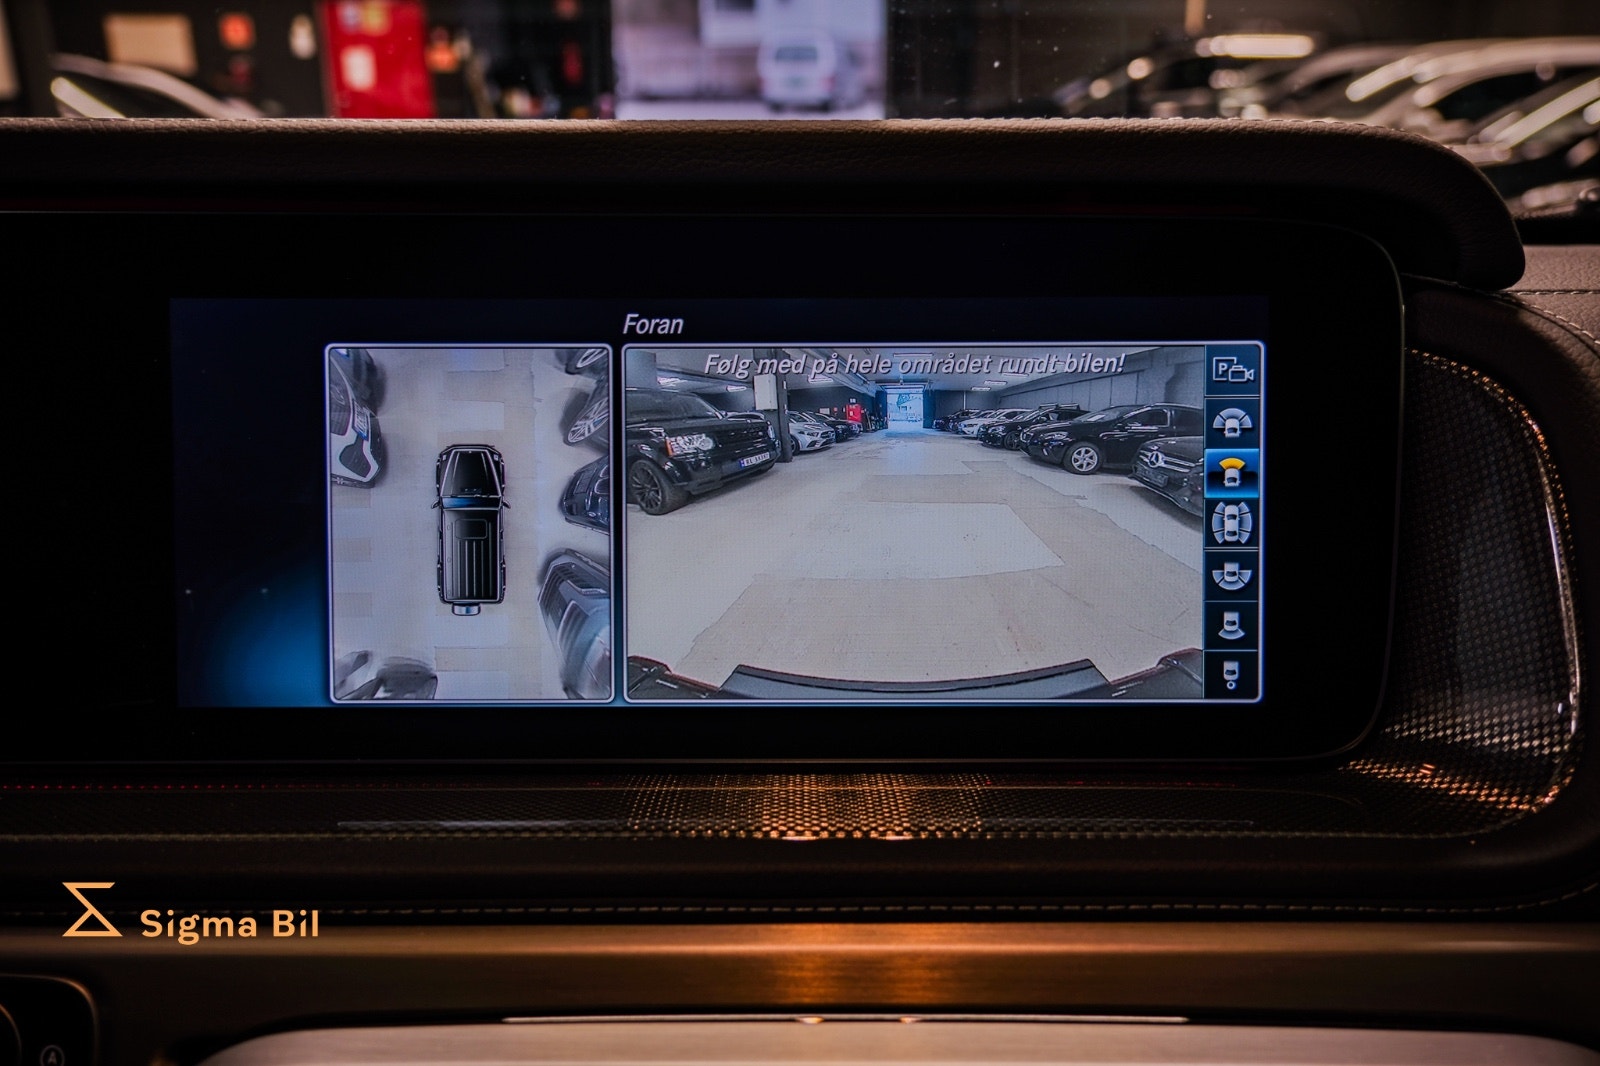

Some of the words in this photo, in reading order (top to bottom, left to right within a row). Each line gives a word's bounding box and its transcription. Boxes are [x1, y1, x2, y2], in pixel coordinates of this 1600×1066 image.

[623, 313, 684, 334] Foran
[704, 354, 751, 379] Følg
[757, 355, 806, 374] med
[811, 353, 838, 378] på
[845, 355, 892, 374] hele
[900, 352, 992, 374] området
[999, 354, 1057, 373] rundt
[1063, 353, 1127, 373] bilen!
[1218, 363, 1228, 374] P
